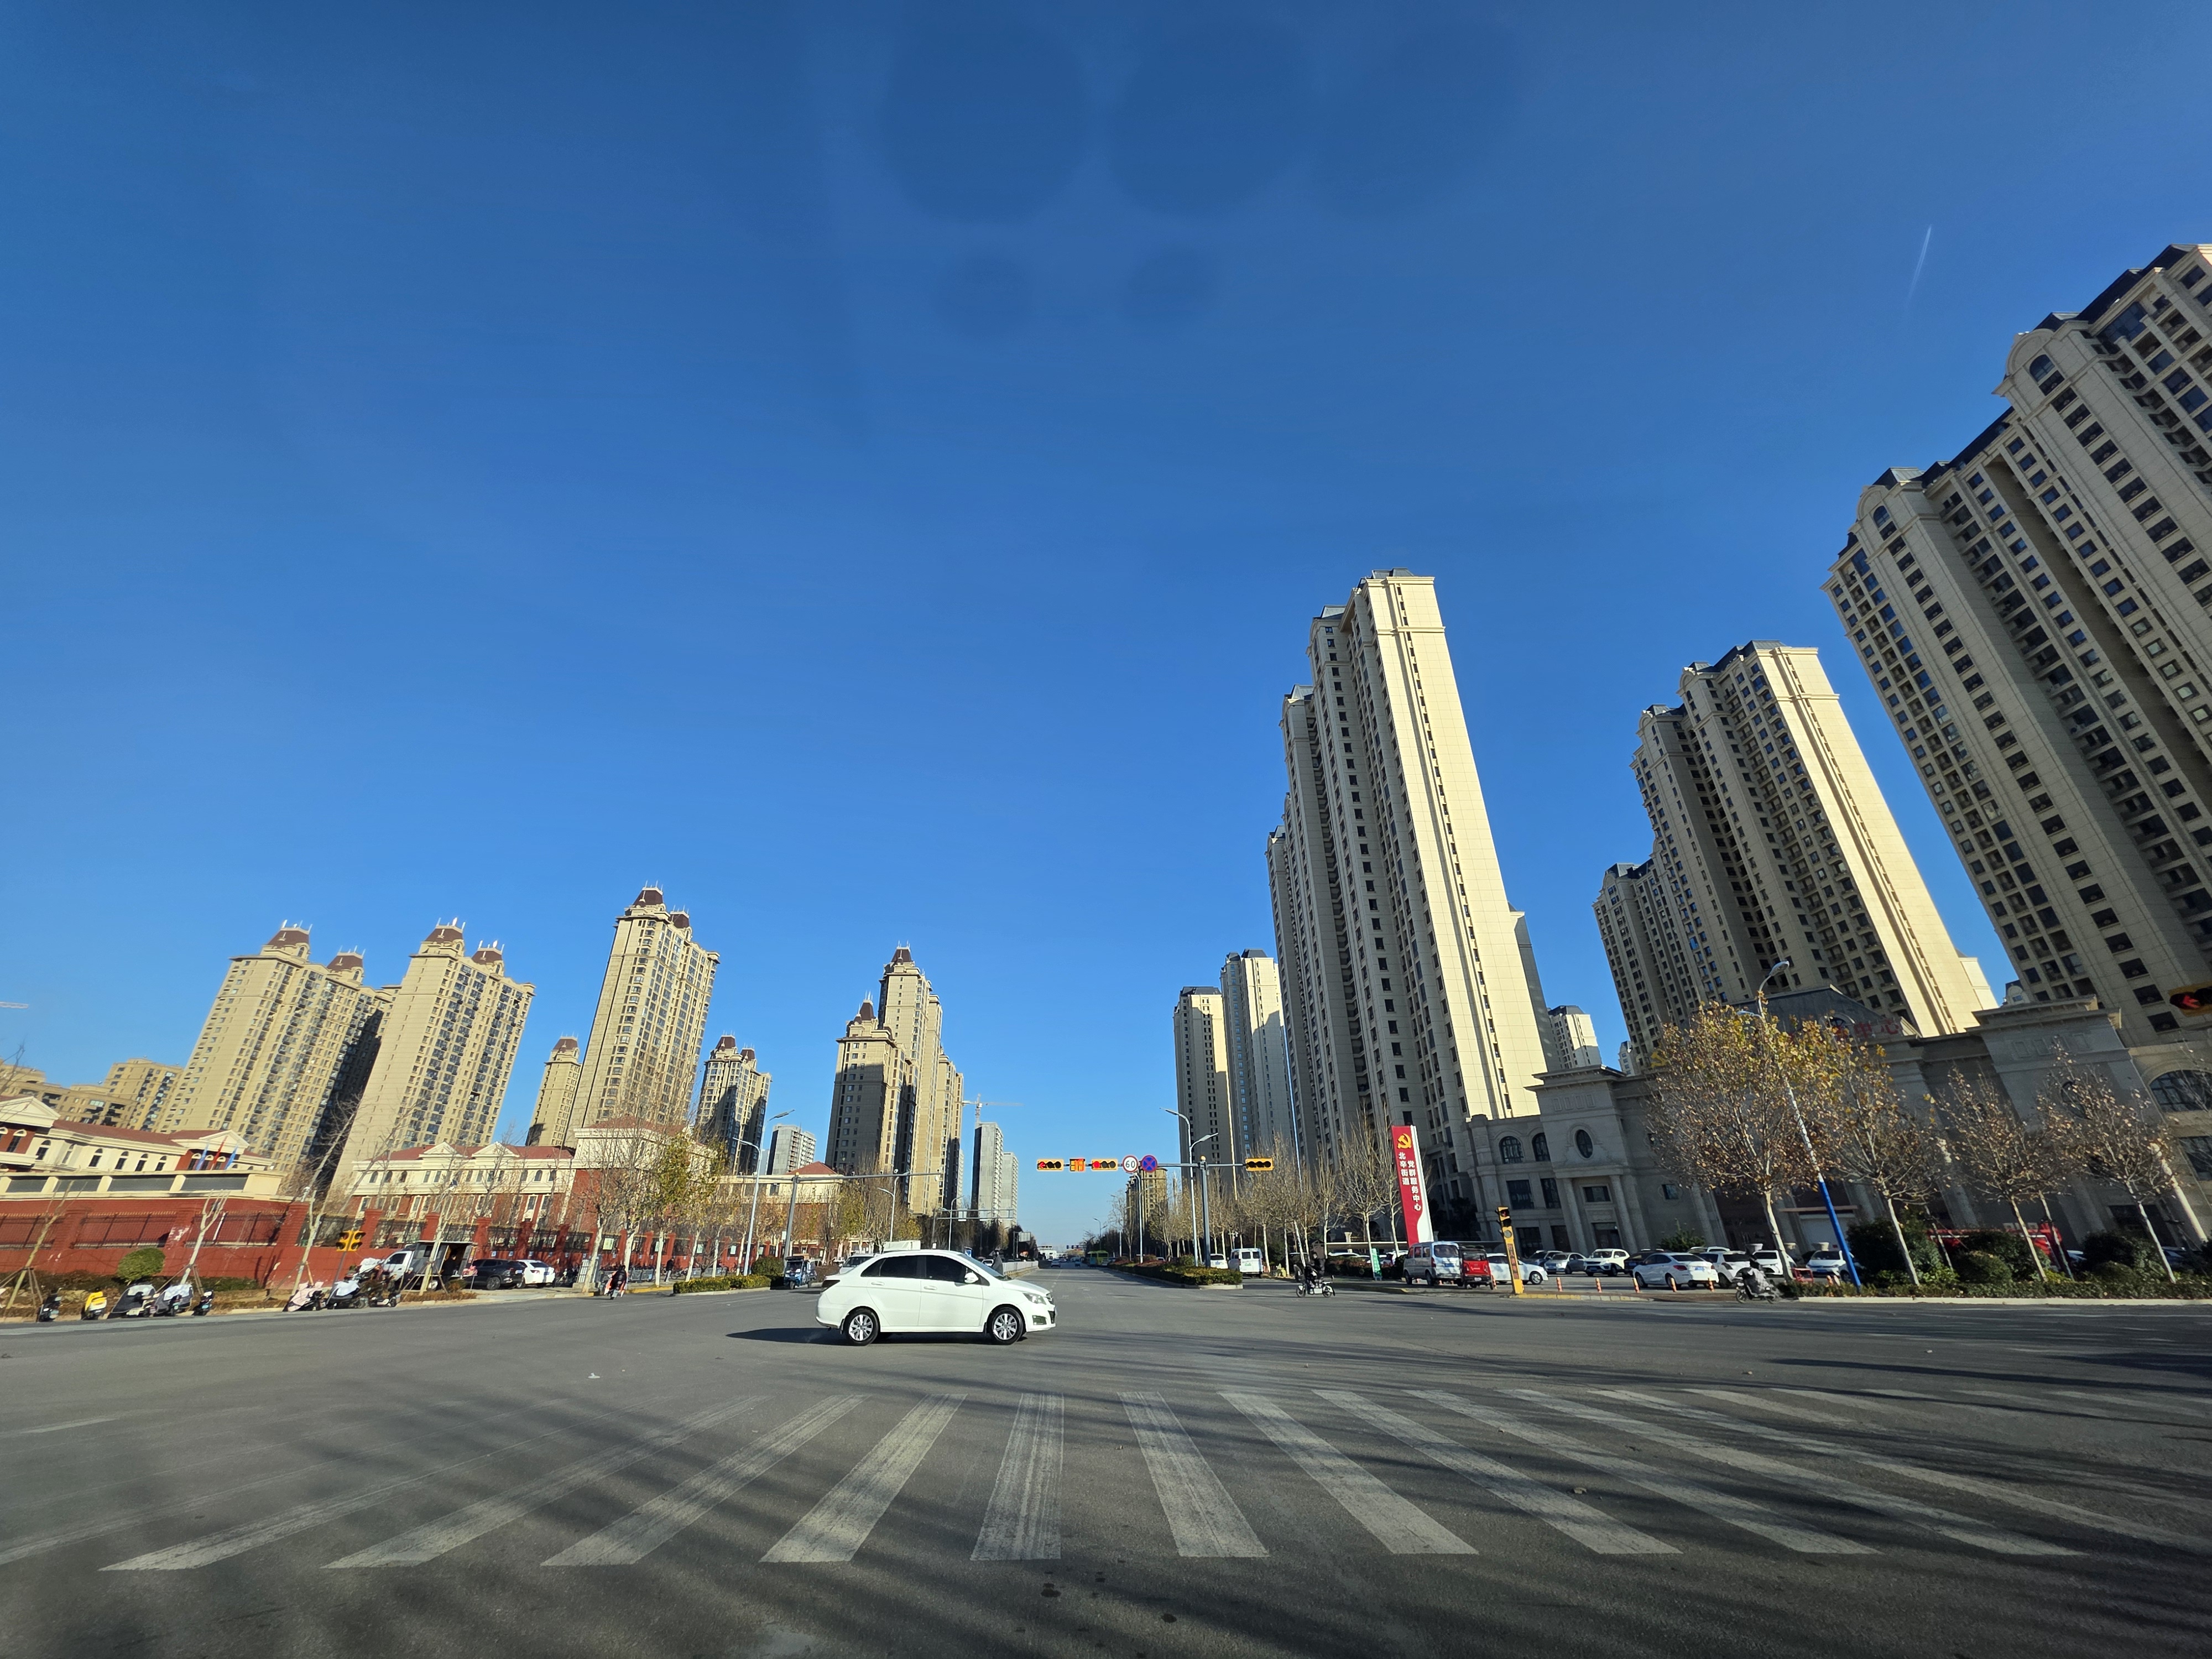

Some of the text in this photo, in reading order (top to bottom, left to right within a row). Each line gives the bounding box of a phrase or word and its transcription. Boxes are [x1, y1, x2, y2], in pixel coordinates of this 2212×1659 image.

[1398, 1152, 1410, 1185] 北辛街道
[1407, 1160, 1421, 1211] 党群服务中心
